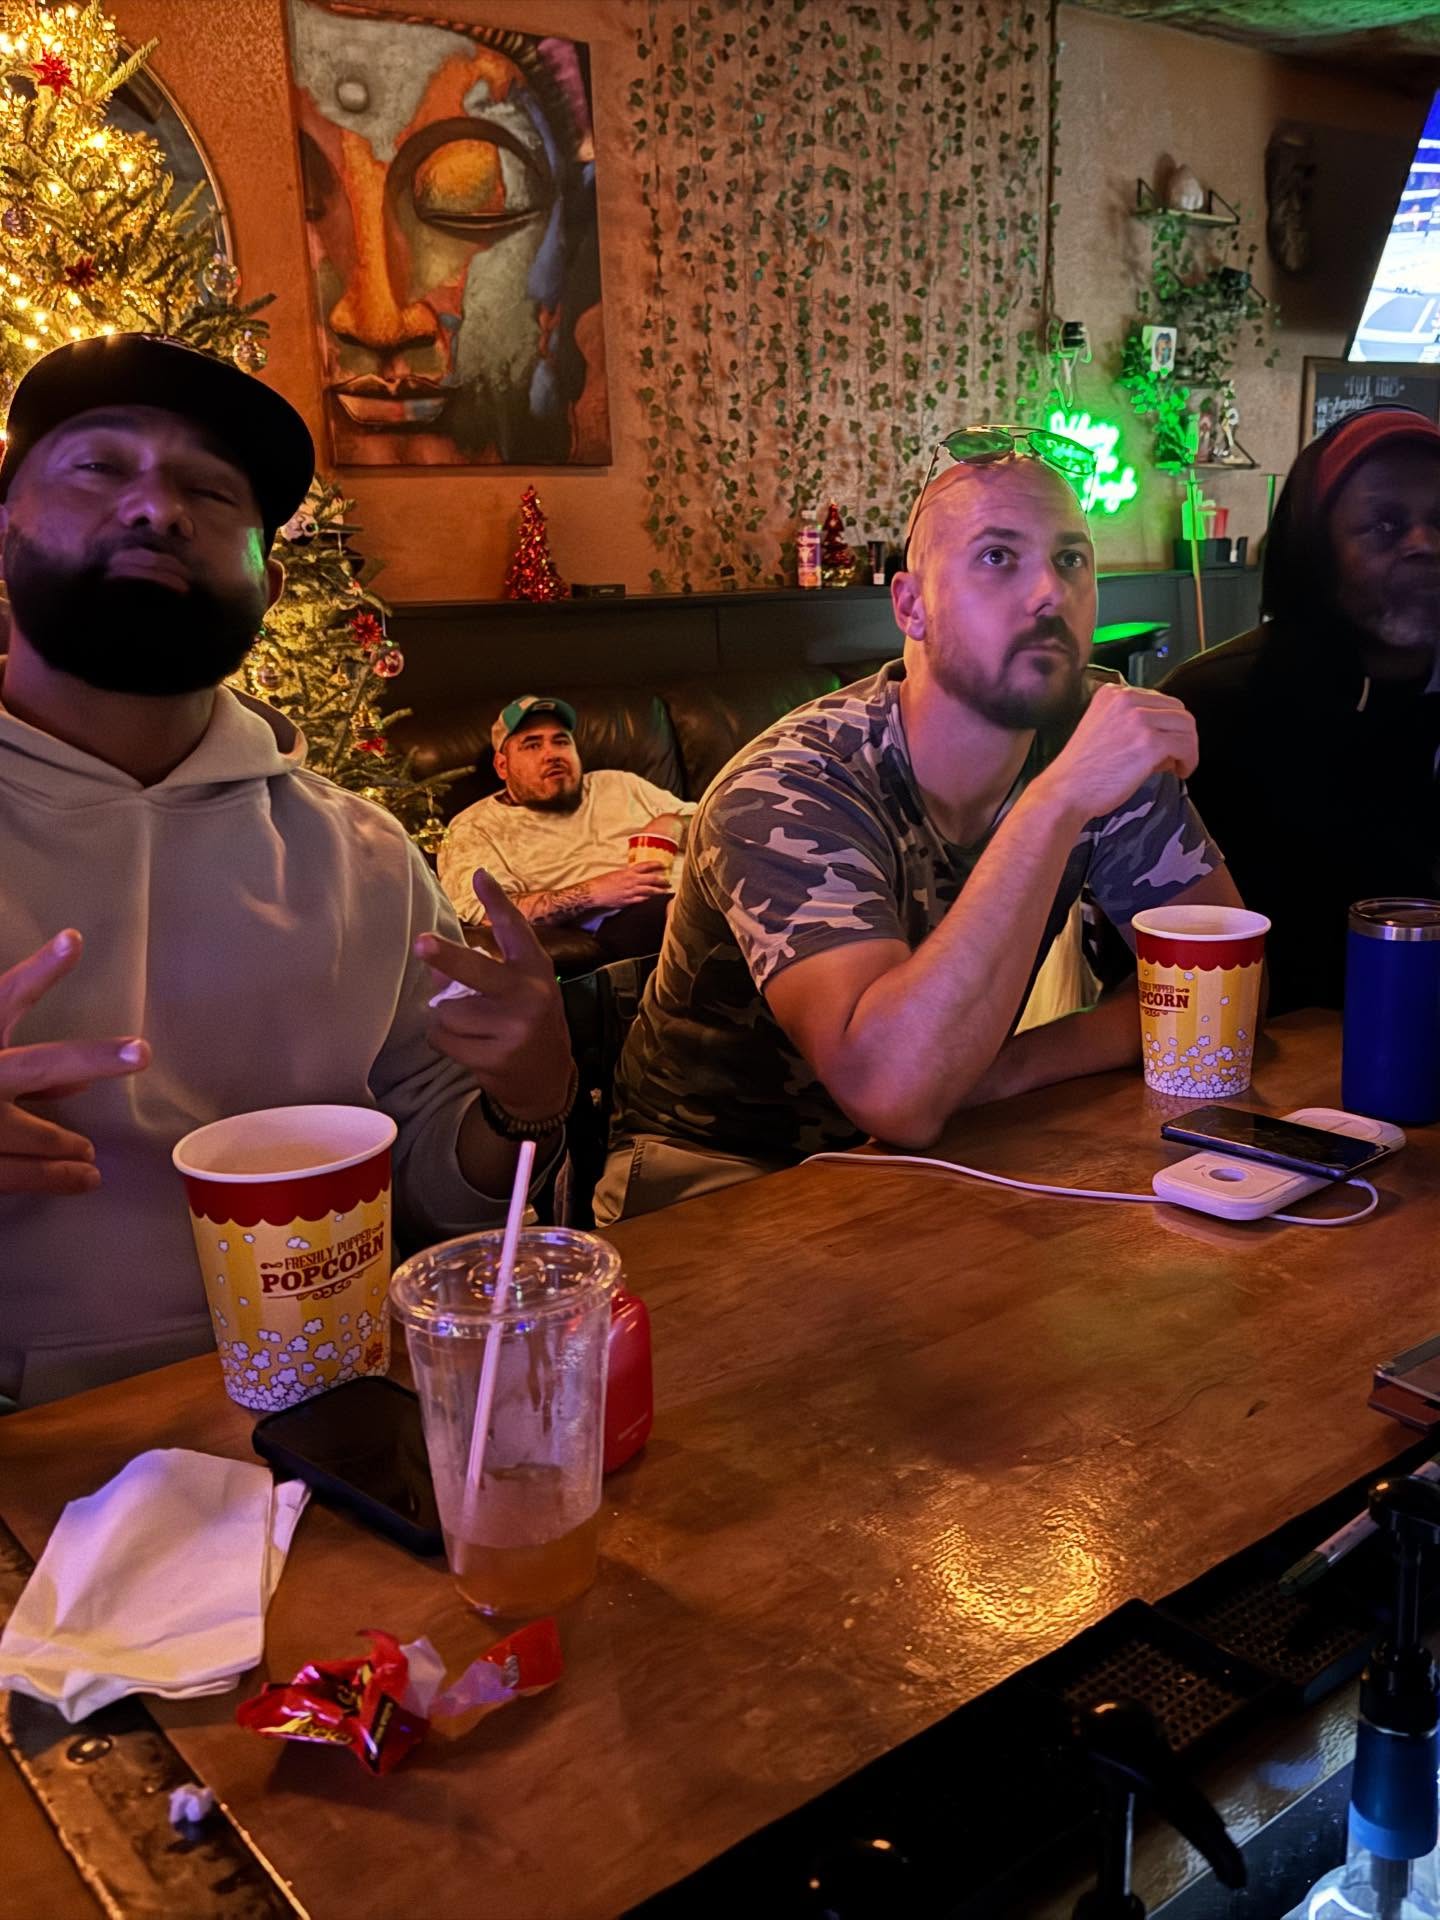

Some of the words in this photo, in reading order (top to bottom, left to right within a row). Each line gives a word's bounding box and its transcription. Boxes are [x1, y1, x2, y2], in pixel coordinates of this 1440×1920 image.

[1140, 990, 1190, 1009] PCORN
[260, 1231, 384, 1293] POPCORN
[284, 1246, 335, 1271] FRESHLY
[337, 1228, 372, 1255] POPPED
